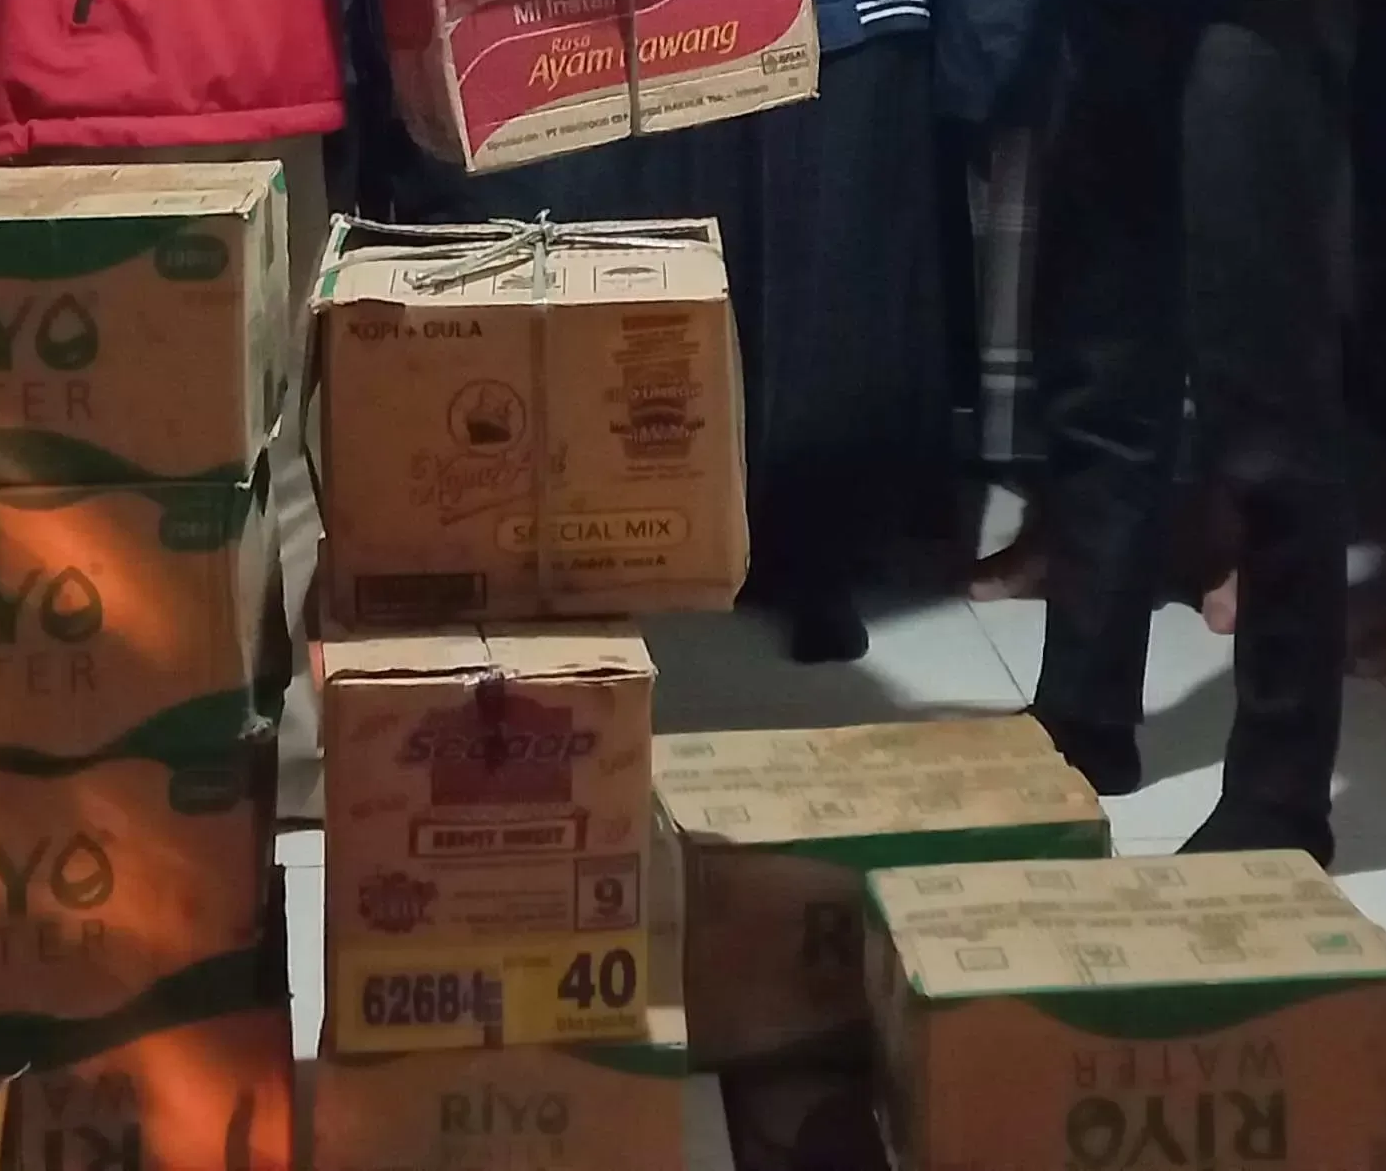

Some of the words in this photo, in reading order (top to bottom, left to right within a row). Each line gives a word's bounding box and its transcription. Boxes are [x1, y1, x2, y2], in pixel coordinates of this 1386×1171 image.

[528, 46, 613, 92] Ayam
[619, 20, 739, 67] awang
[551, 34, 591, 54] Rasa
[514, 521, 613, 545] SCIAL
[625, 518, 672, 539] MIX
[594, 876, 624, 916] 9
[557, 948, 637, 1010] 40
[1073, 1036, 1285, 1089] WATER
